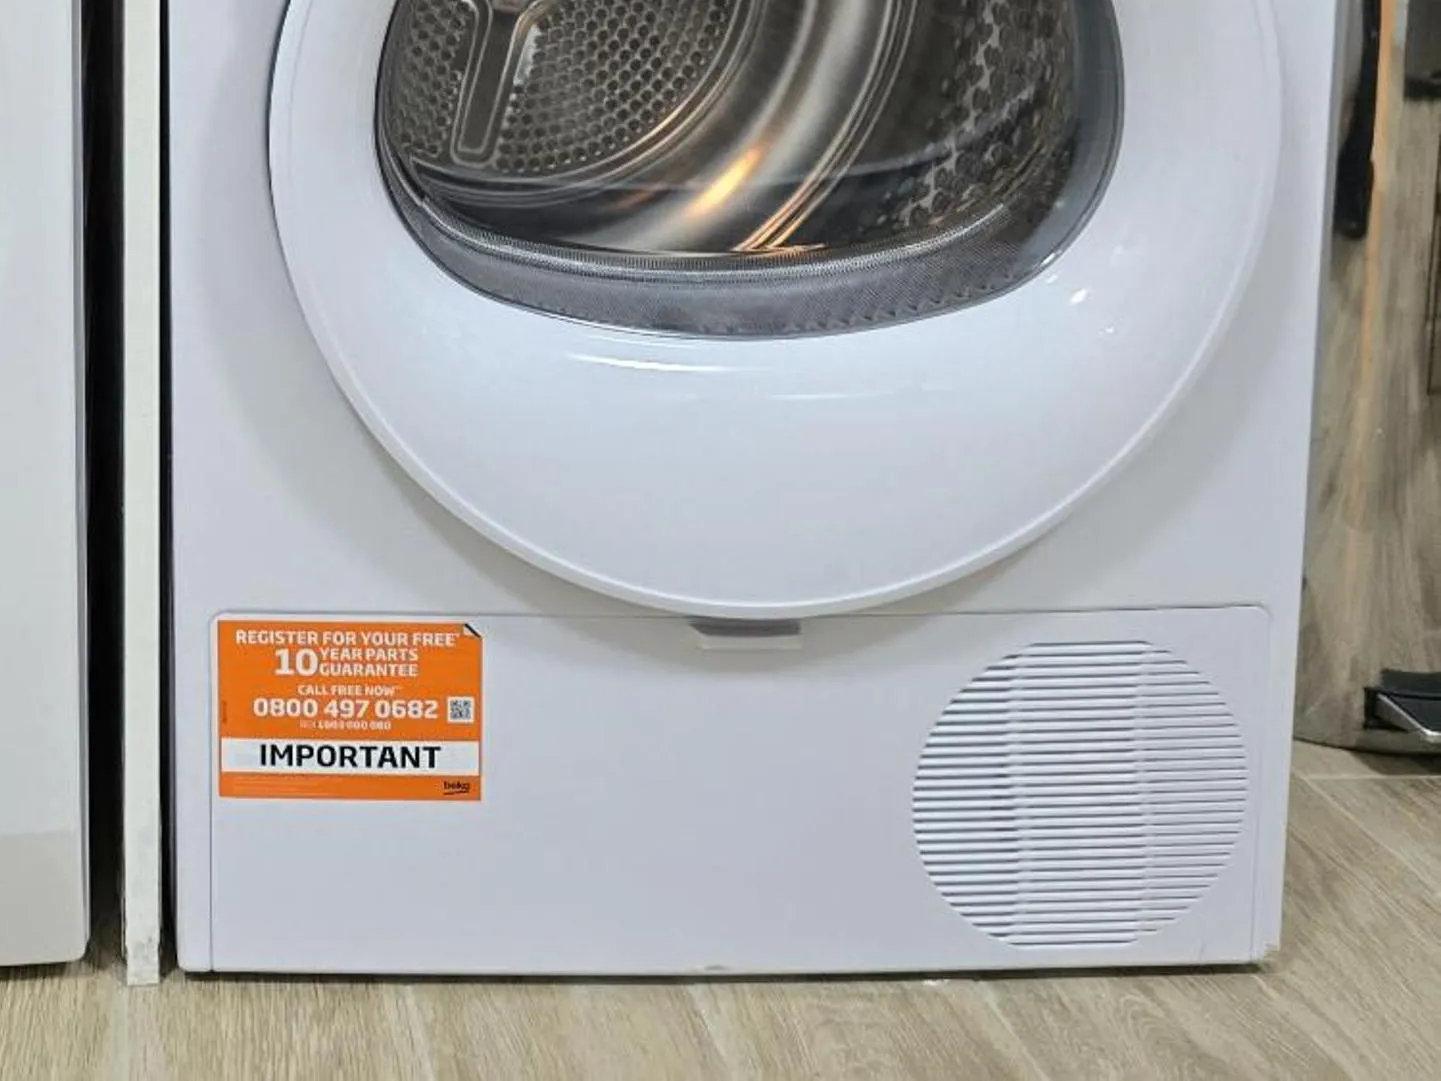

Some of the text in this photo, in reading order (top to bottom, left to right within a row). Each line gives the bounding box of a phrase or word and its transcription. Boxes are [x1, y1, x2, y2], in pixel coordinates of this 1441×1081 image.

[235, 629, 318, 645] REGISTER
[322, 630, 357, 646] FOR
[361, 631, 408, 647] YOUR
[274, 648, 418, 676] 10 YEAR PARTS
[319, 663, 419, 677] GUARANTEE
[298, 684, 329, 696] CALL
[330, 685, 363, 696] FREE
[253, 698, 439, 719] 0800 497 0682
[260, 744, 441, 768] IMPORTANT
